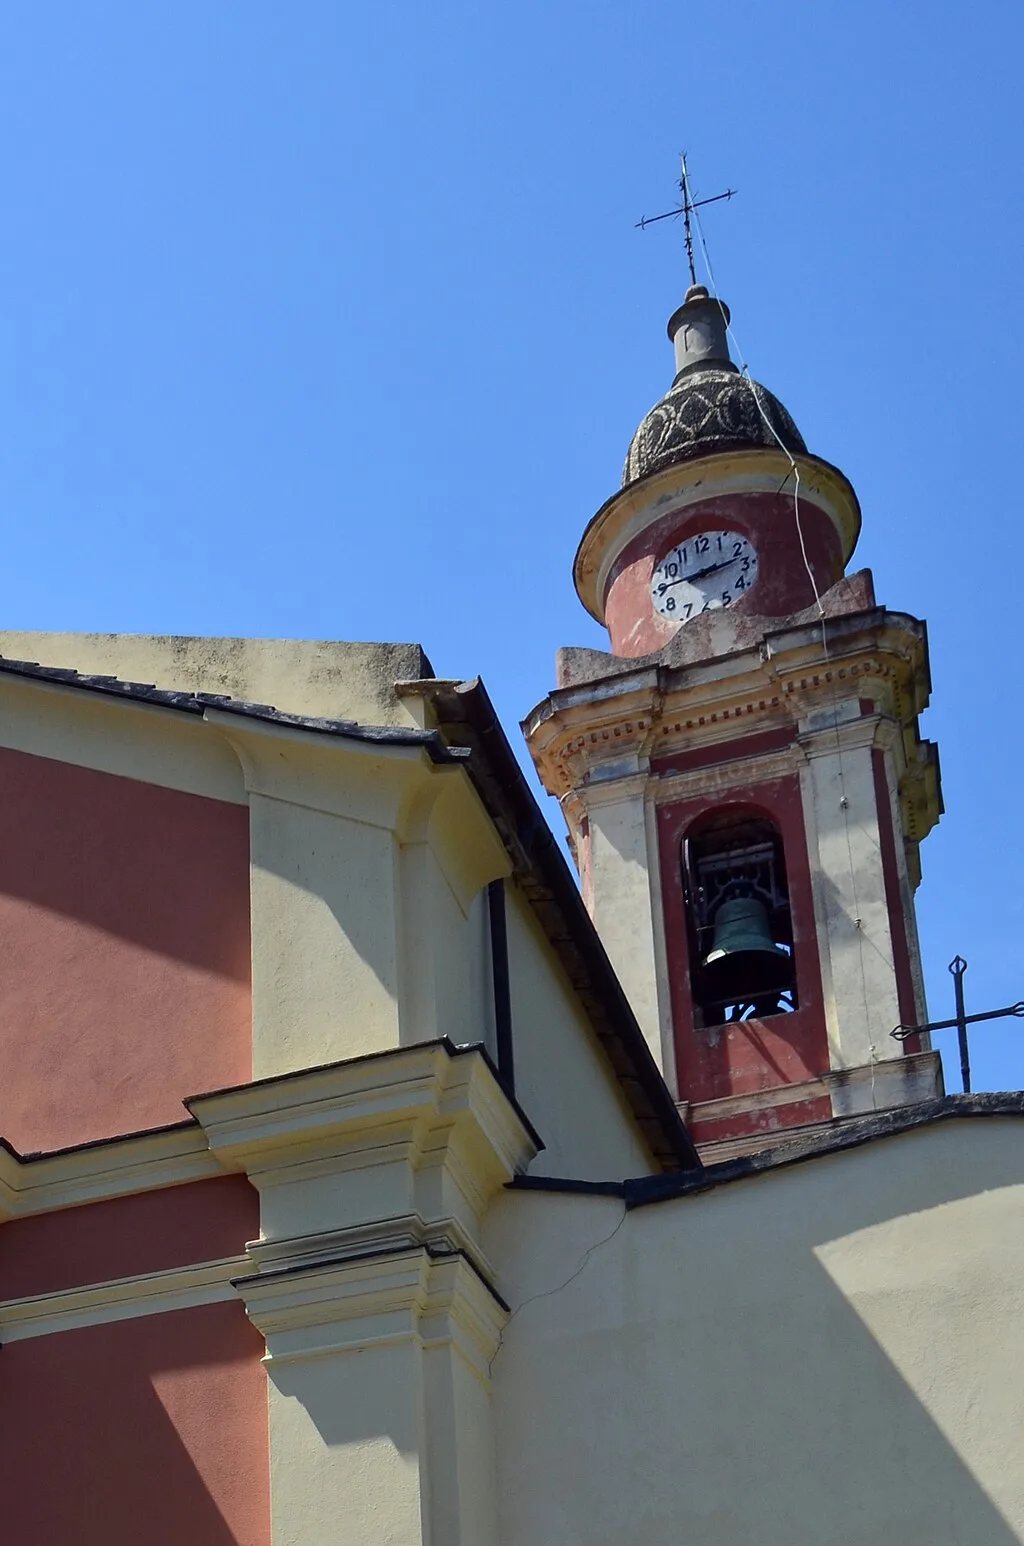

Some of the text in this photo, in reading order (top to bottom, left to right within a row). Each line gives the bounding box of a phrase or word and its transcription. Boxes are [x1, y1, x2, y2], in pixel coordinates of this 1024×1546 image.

[694, 537, 710, 554] 12
[716, 536, 722, 551] 1
[732, 542, 742, 557] 2
[677, 547, 687, 564] 11
[664, 563, 678, 579] 10
[740, 556, 750, 571] 3
[734, 575, 745, 590] 4
[658, 583, 667, 598] 9
[666, 597, 676, 611] 8
[722, 591, 731, 607] 5
[683, 603, 693, 618] 7
